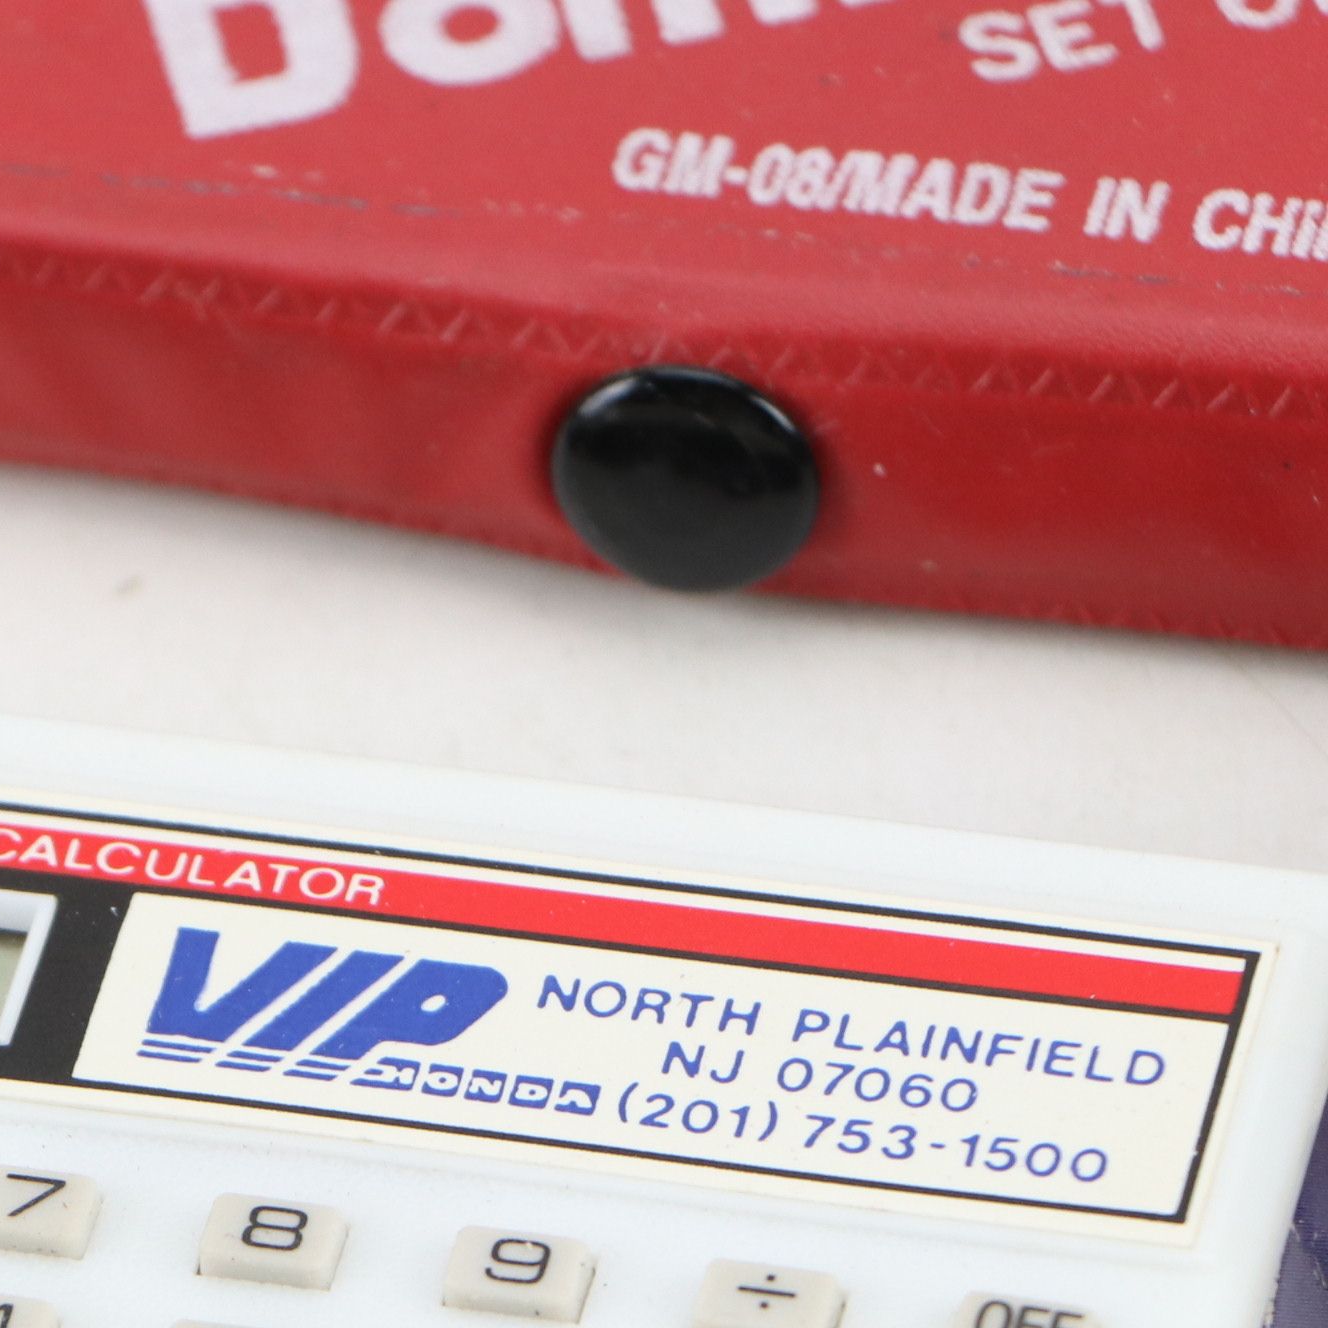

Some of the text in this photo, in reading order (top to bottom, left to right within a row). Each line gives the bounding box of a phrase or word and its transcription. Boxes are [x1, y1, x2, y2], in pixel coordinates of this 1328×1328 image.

[958, 0, 1165, 82] SET
[612, 127, 1328, 262] GM-08/MADE IN CHI
[147, 927, 509, 1061] VIP
[537, 974, 1168, 1087] NORTH PLAINFIELD
[350, 1057, 602, 1116] HONDA
[662, 1041, 980, 1114] NJ 07060
[617, 1085, 1110, 1186] (201) 753-1500
[5, 1172, 67, 1218] 7
[241, 1206, 309, 1252] 8
[484, 1238, 552, 1286] 9
